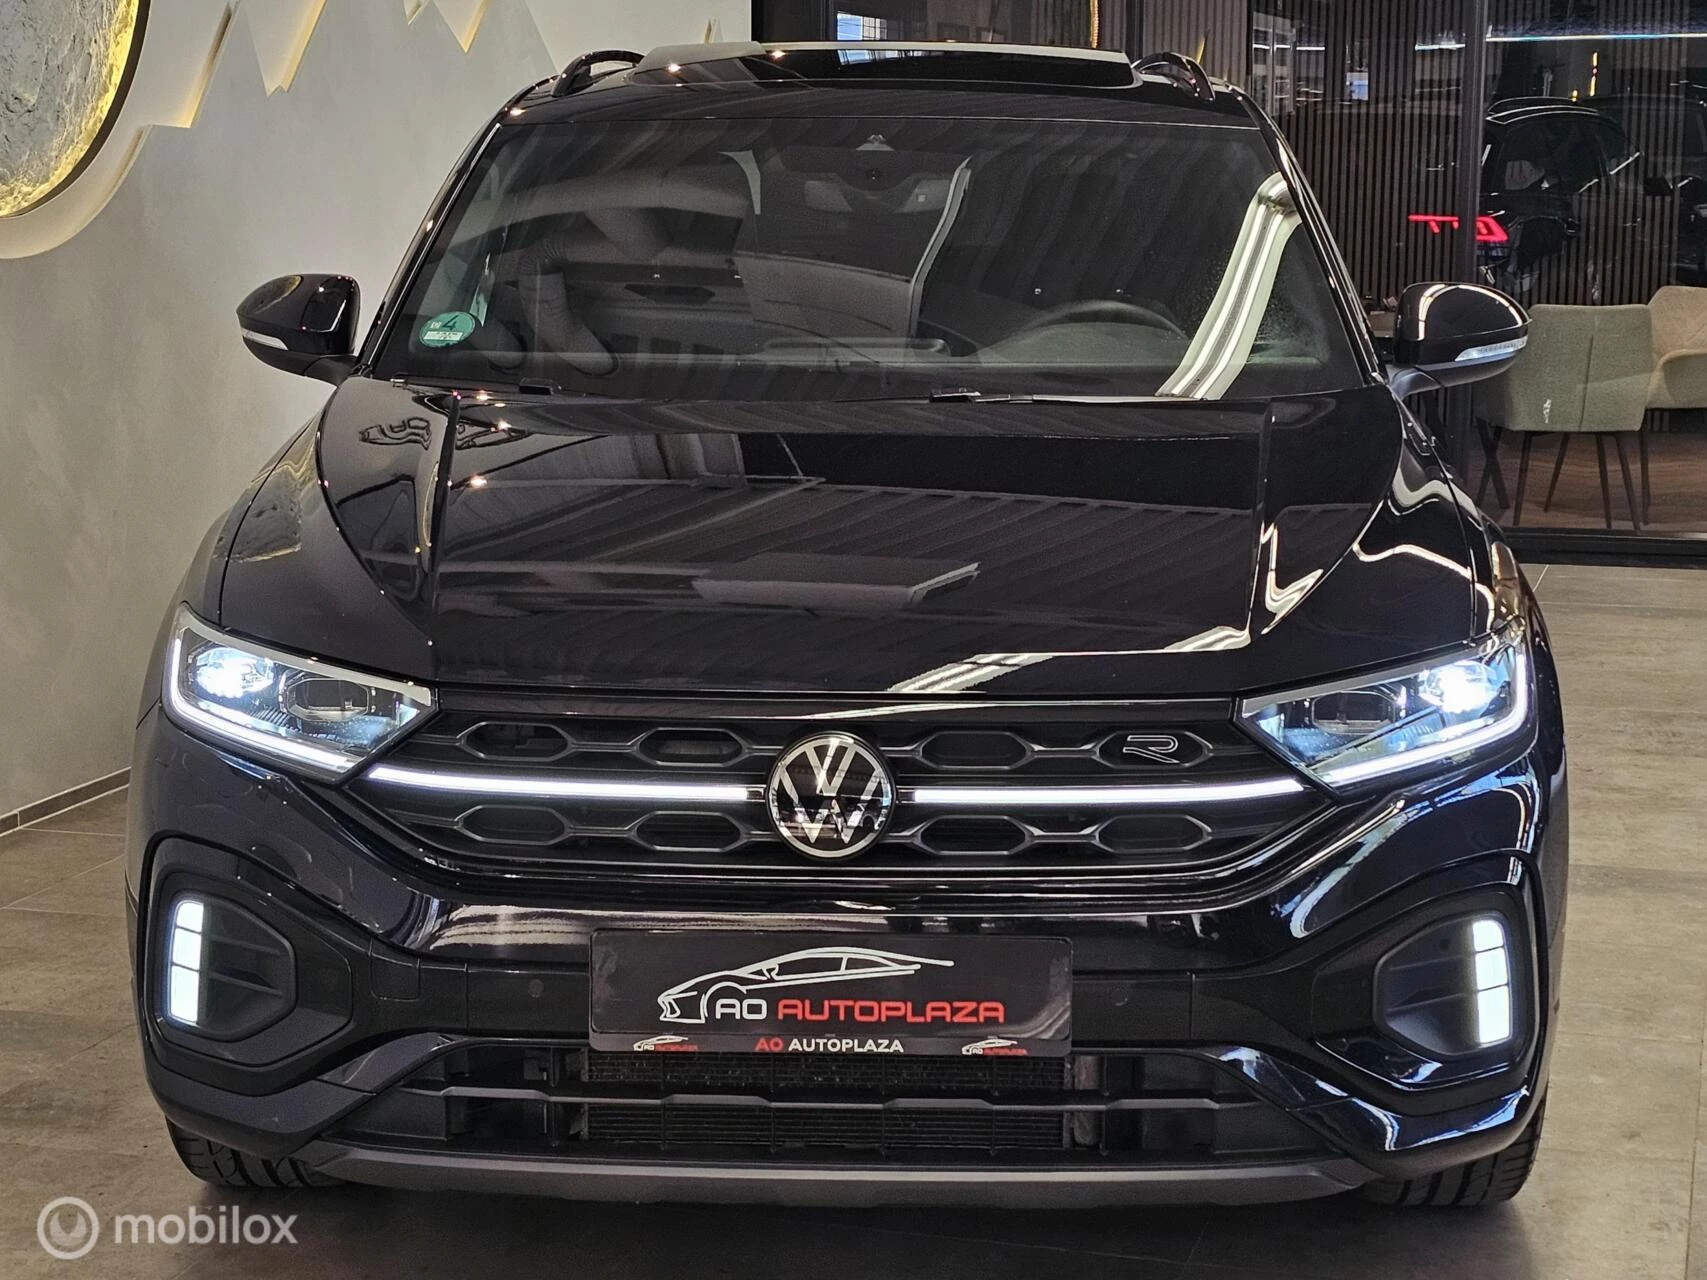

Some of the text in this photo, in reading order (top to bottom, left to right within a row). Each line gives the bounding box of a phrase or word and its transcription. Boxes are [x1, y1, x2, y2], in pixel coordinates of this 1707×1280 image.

[442, 314, 459, 331] 4
[1122, 735, 1179, 764] R
[715, 998, 1005, 1024] AO AUTOPLAZA
[755, 1038, 904, 1053] AO AUTOPLAZA
